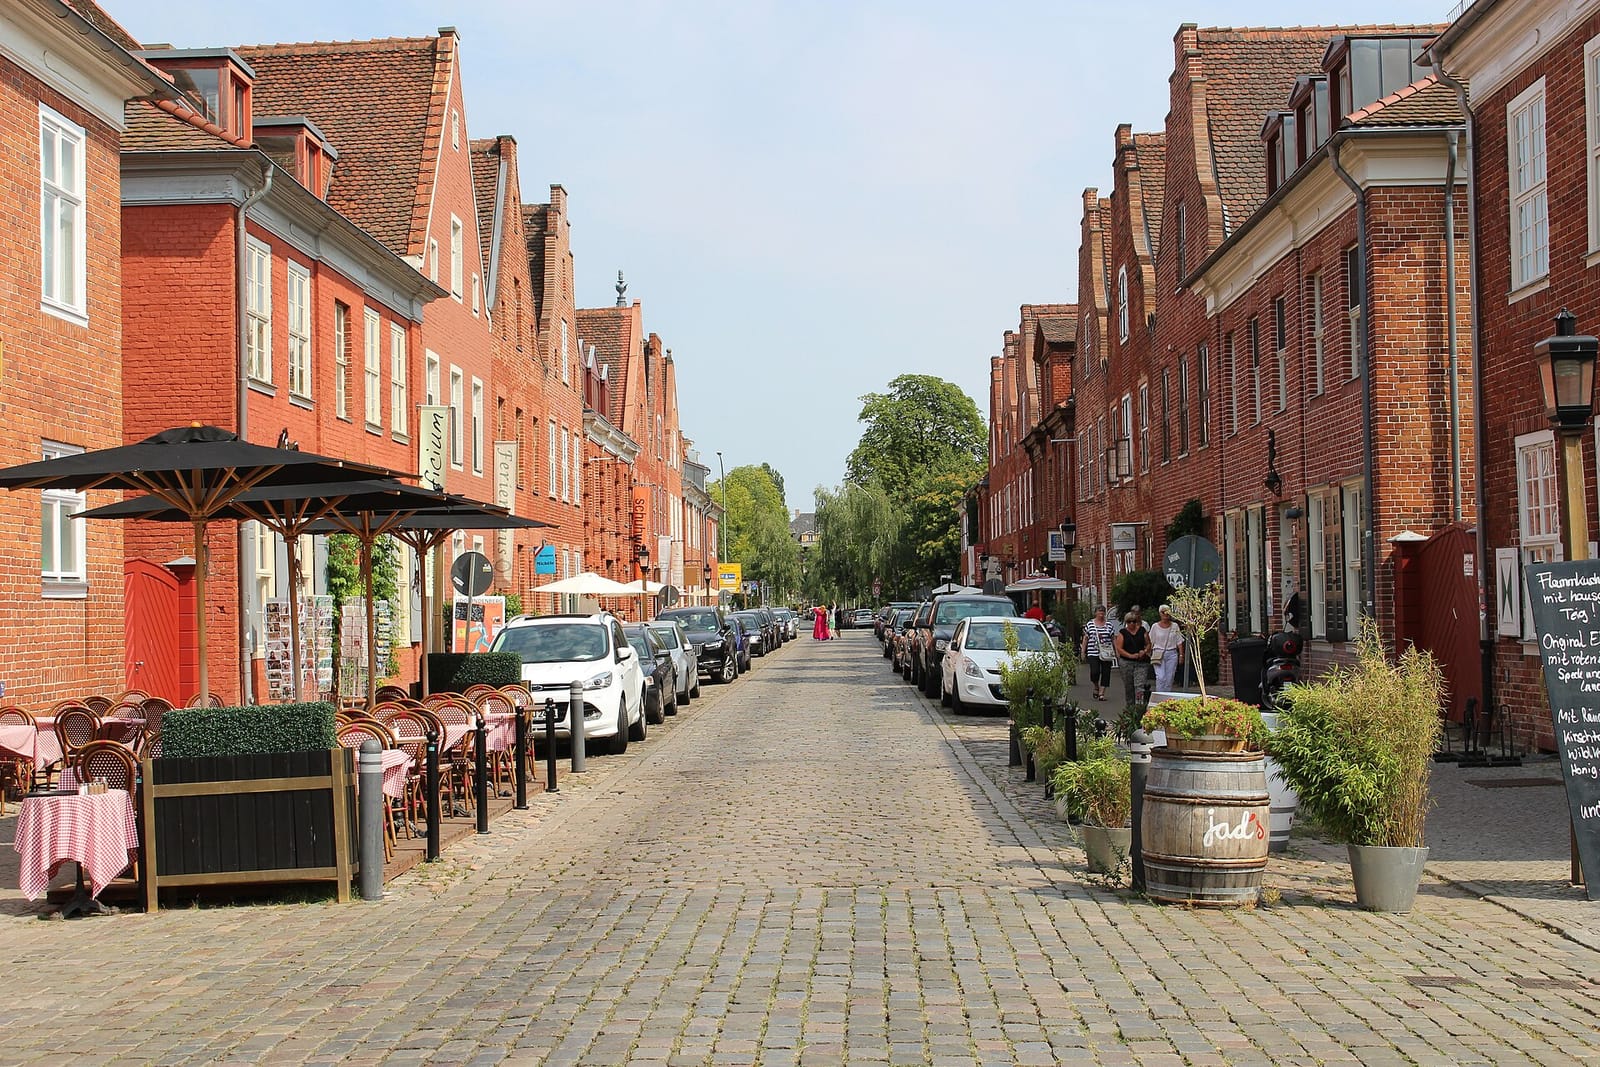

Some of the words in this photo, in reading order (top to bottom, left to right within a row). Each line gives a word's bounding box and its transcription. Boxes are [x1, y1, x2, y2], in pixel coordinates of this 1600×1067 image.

[634, 498, 646, 562] schuhwe
[1543, 591, 1567, 604] mit
[1543, 629, 1587, 651] Original
[1548, 651, 1570, 666] mit
[1570, 650, 1597, 666] roten
[1558, 708, 1579, 724] Mit
[1570, 762, 1598, 779] Honig
[1203, 808, 1264, 847] jad's
